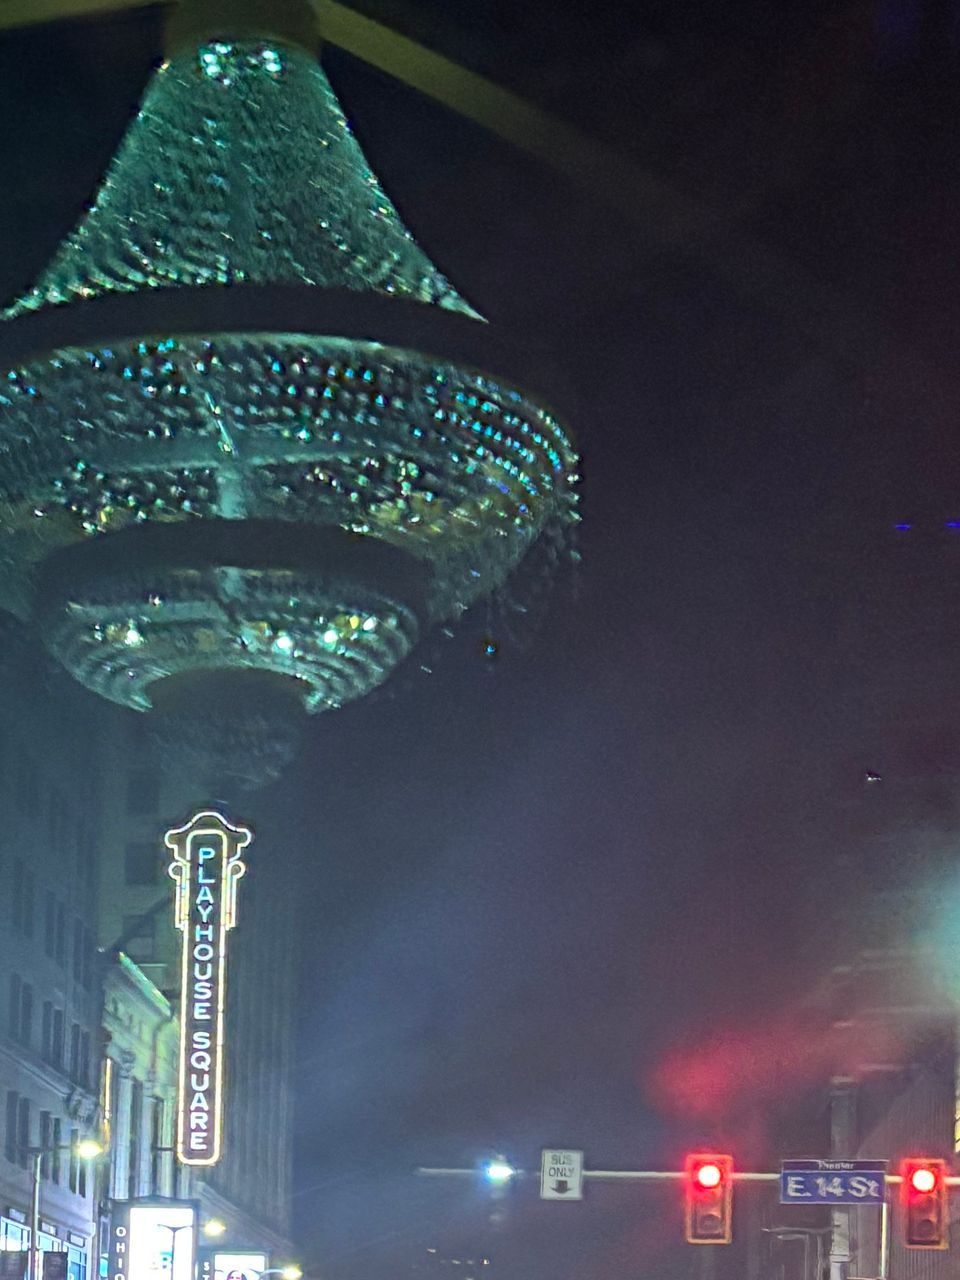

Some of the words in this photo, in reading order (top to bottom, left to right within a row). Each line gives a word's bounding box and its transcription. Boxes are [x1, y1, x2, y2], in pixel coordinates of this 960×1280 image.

[193, 847, 215, 1020] PLAYHOUSE
[189, 1031, 212, 1150] SQUARE
[551, 1154, 572, 1166] BUS
[548, 1167, 575, 1178] ONLY
[816, 1177, 845, 1198] 14
[847, 1176, 880, 1198] St
